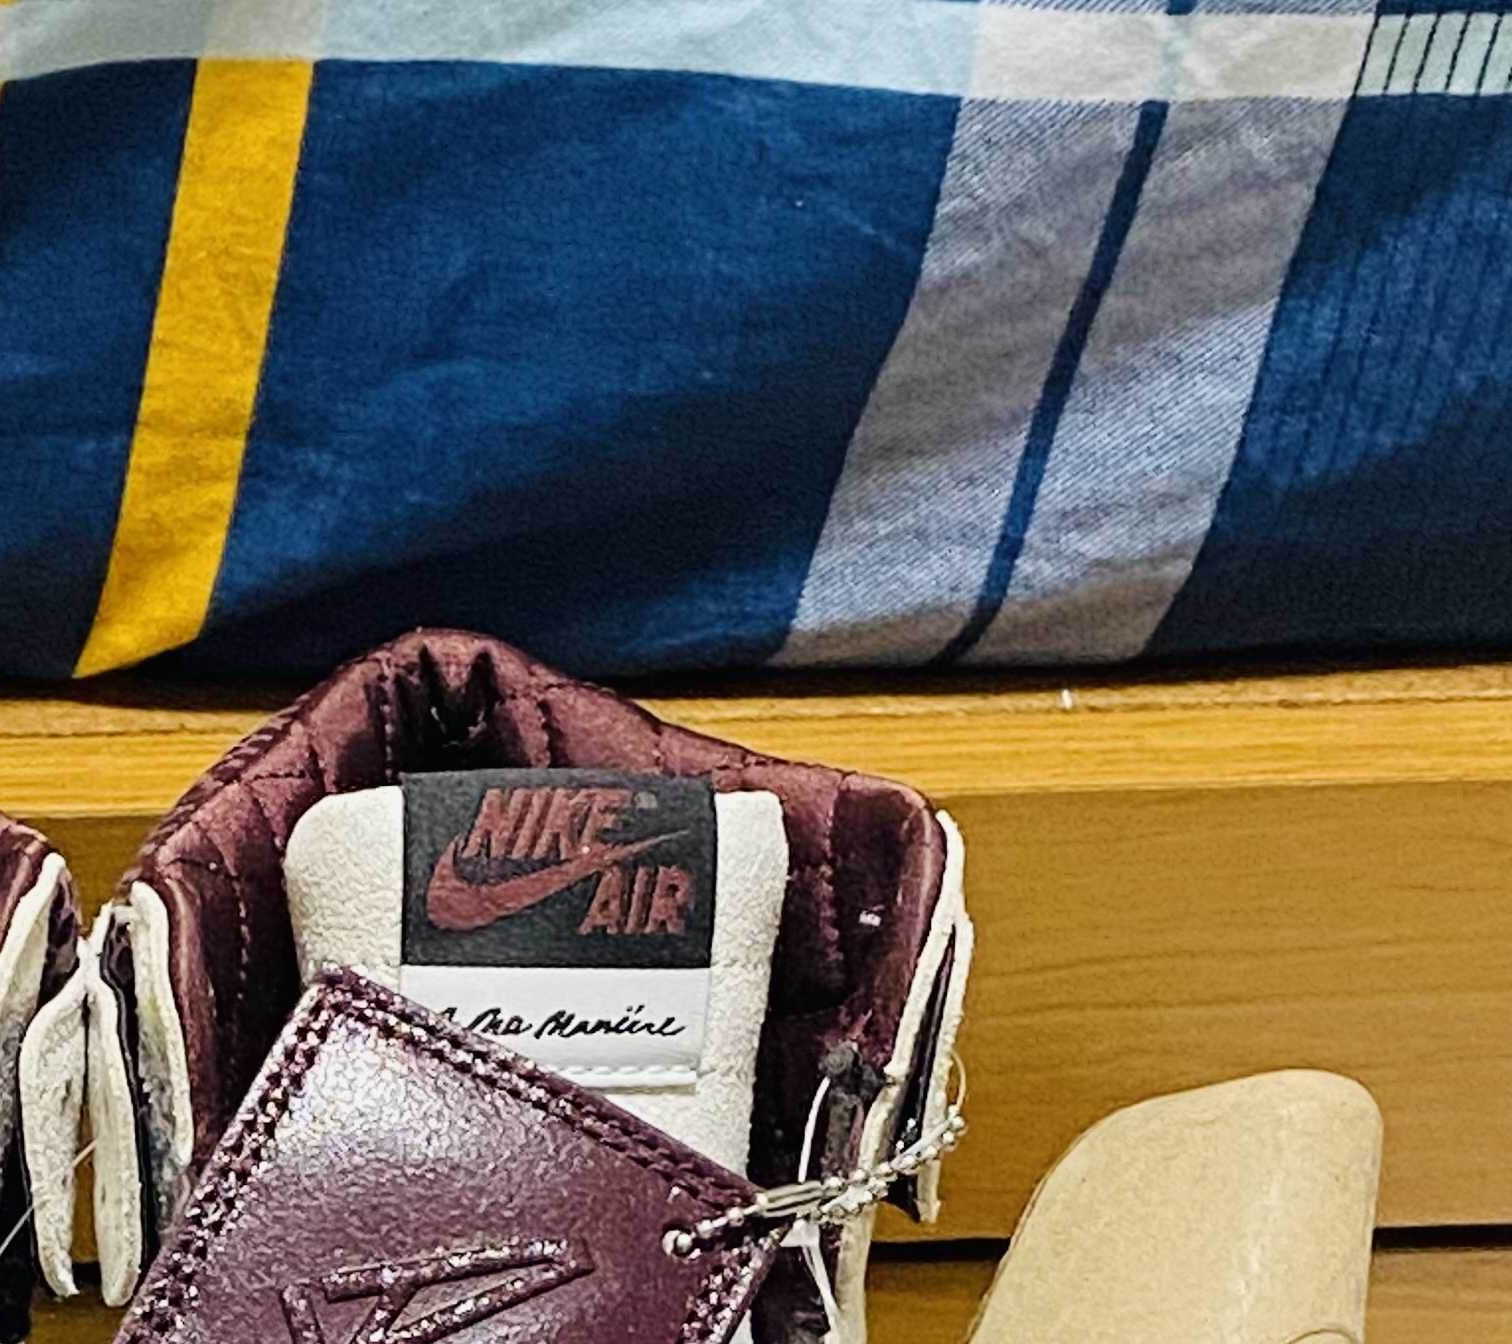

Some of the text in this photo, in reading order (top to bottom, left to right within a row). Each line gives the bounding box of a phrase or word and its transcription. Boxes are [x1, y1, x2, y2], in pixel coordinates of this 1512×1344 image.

[462, 788, 630, 860] NIKE
[580, 865, 688, 934] AIR
[465, 1007, 532, 1035] Ma
